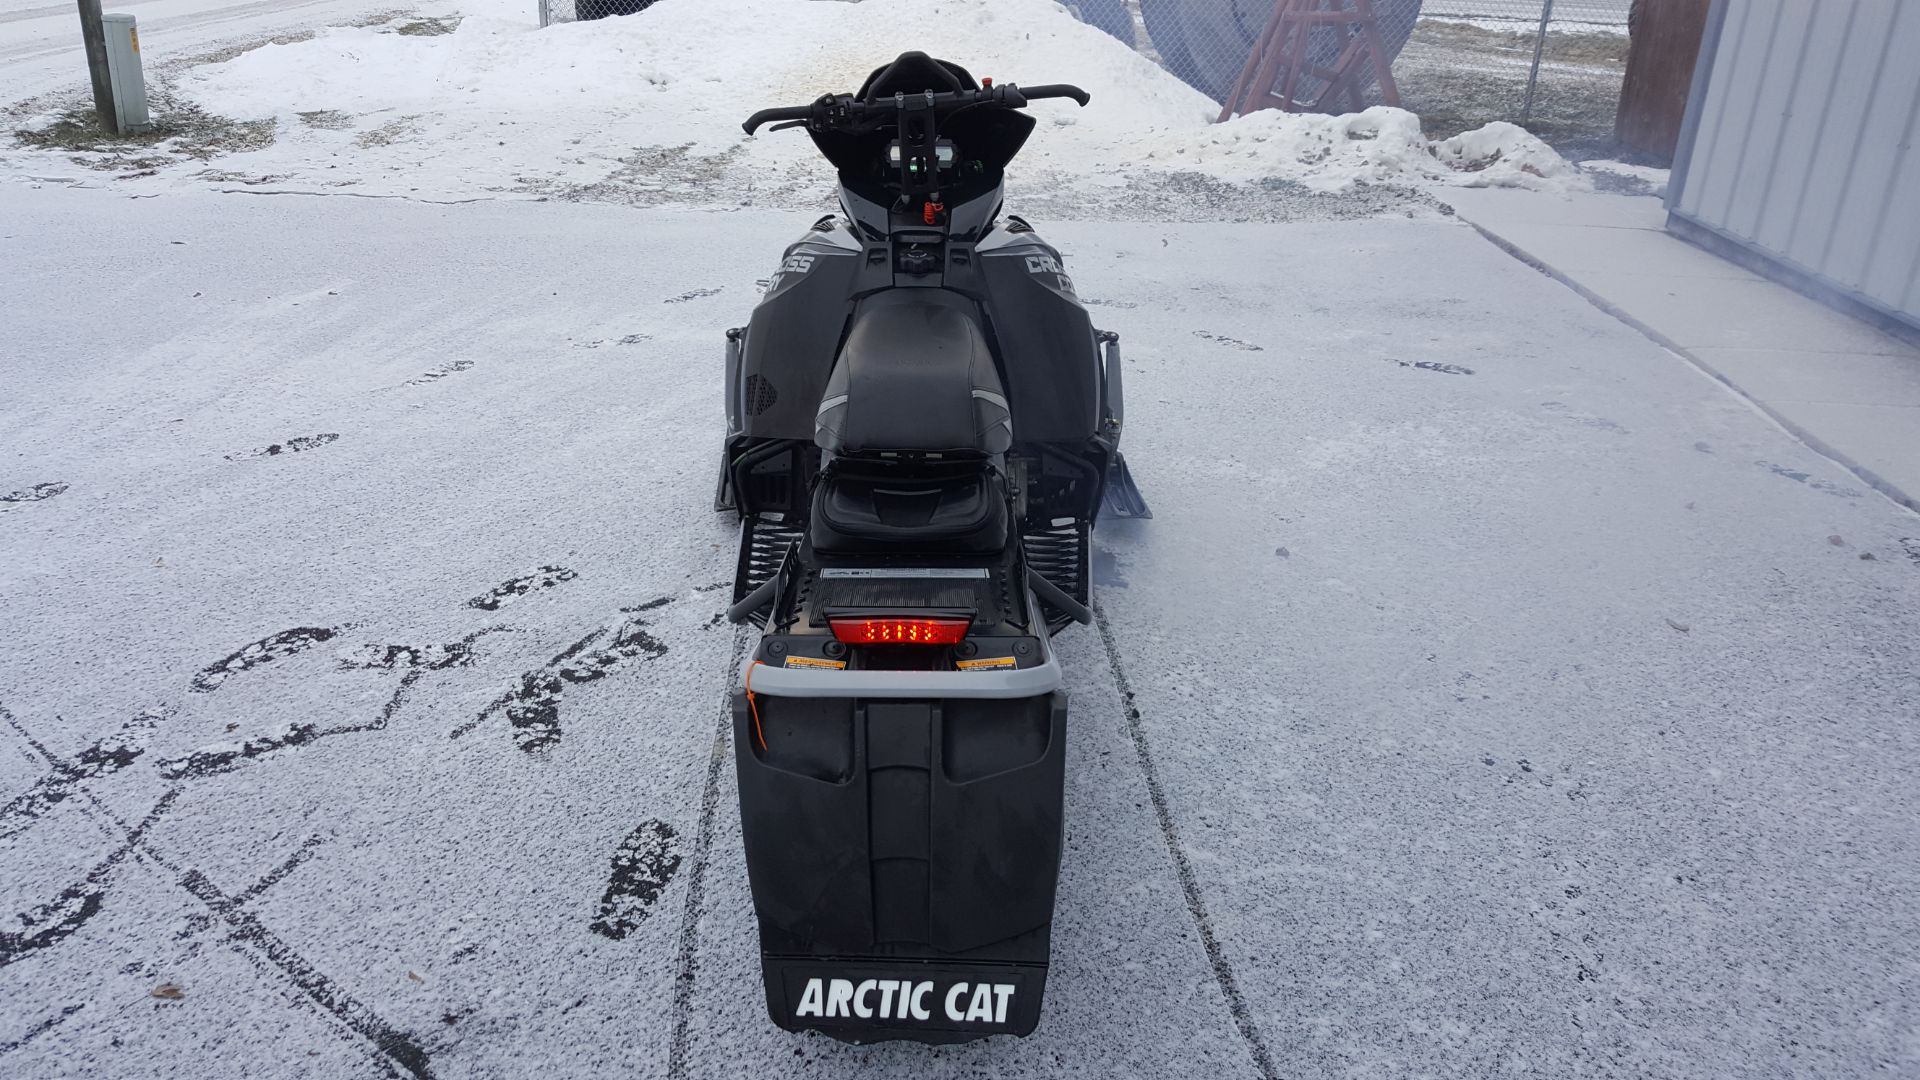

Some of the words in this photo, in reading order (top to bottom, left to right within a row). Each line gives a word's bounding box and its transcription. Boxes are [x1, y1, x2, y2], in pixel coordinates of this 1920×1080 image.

[779, 256, 815, 272] OSS
[1025, 256, 1064, 273] CRO
[796, 978, 934, 1020] ARCTIC
[944, 982, 1015, 1023] CAT
